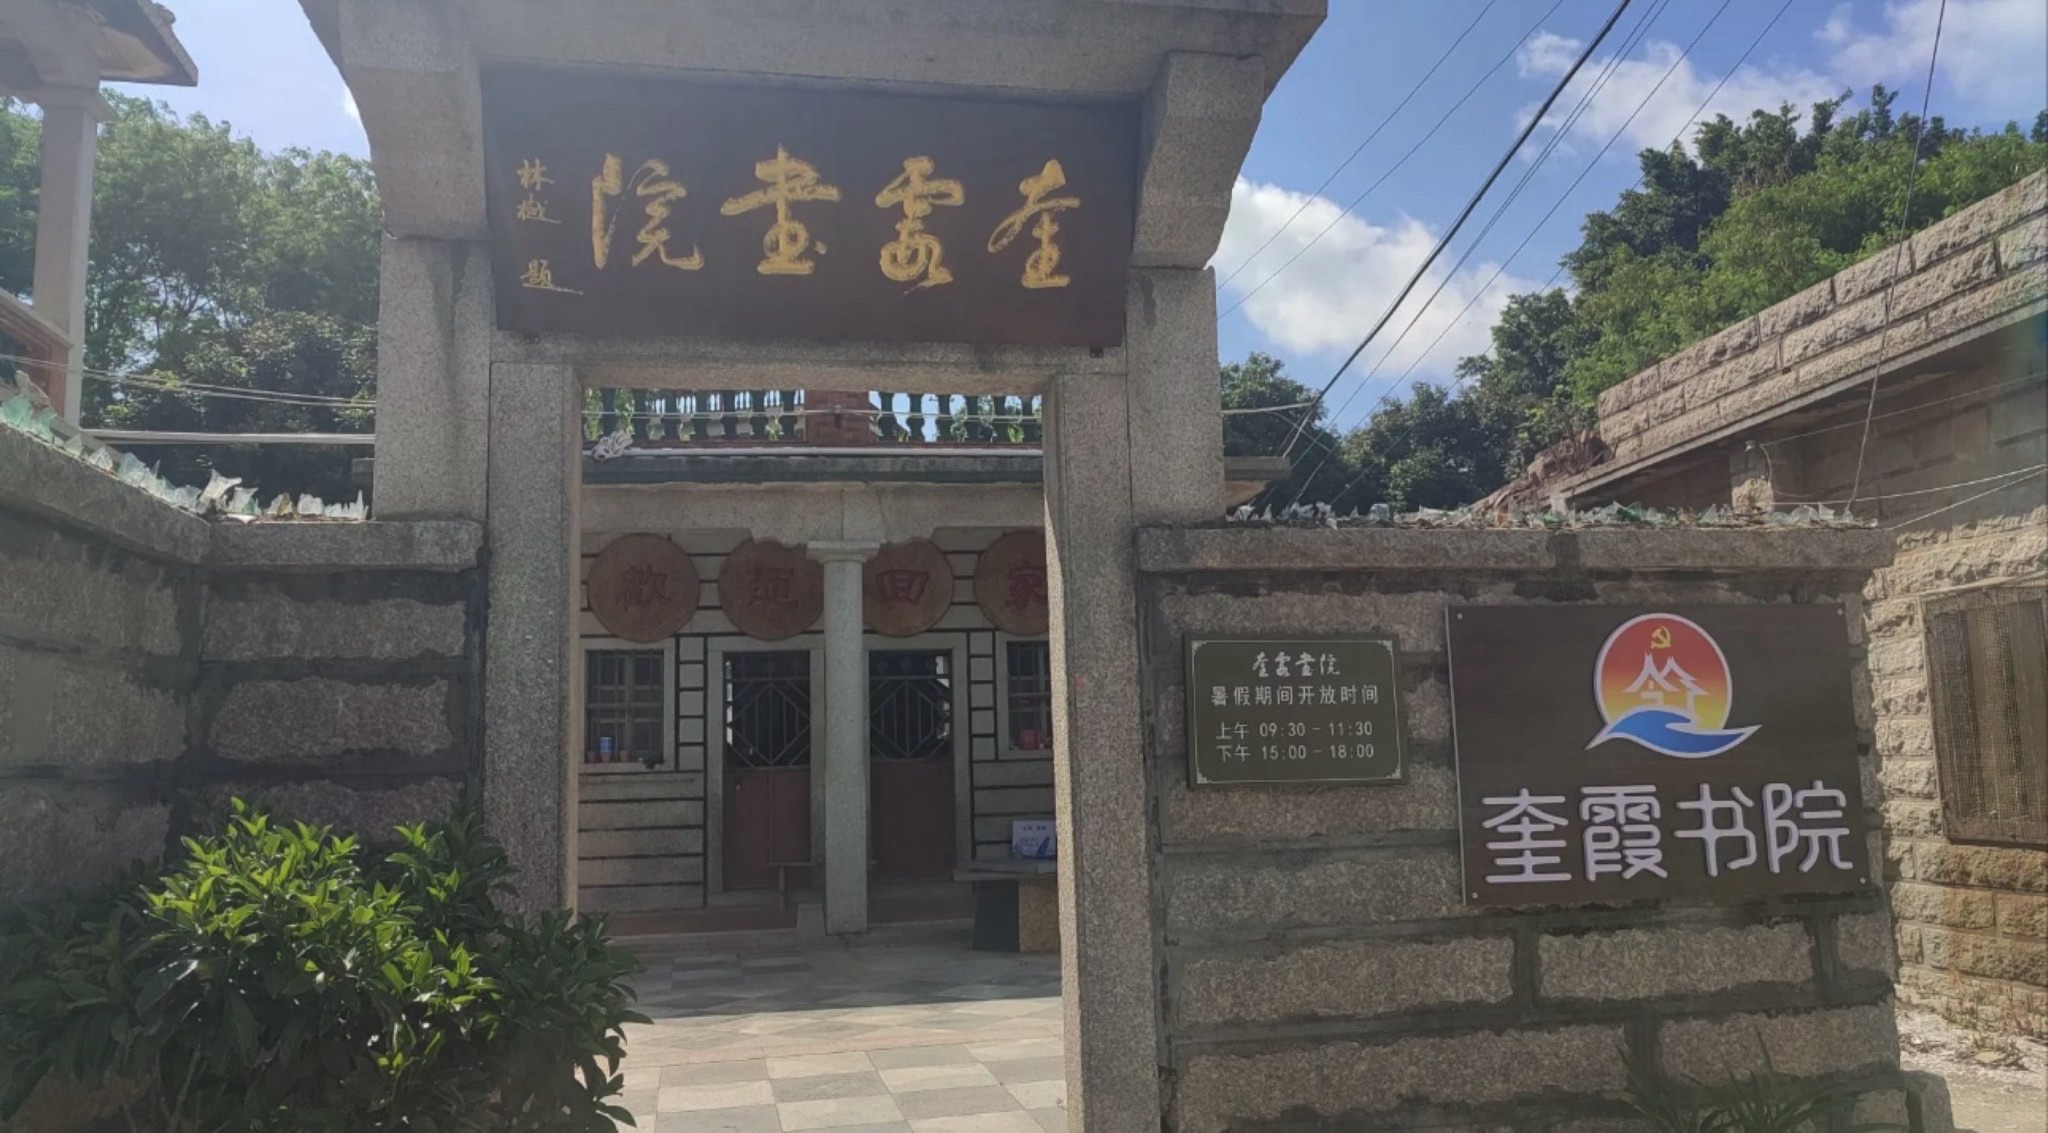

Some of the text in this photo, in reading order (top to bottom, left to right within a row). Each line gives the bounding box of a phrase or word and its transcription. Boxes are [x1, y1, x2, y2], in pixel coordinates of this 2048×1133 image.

[1211, 685, 1379, 706] 暑假期间开放时间
[1216, 721, 1249, 739] 上午
[1259, 722, 1305, 737] 09:30
[1328, 721, 1373, 736] 11:30
[1216, 744, 1250, 762] 下午
[1262, 745, 1306, 760] 15:00
[1330, 744, 1374, 759] 18:00
[1482, 780, 1854, 884] 奎霞书院
